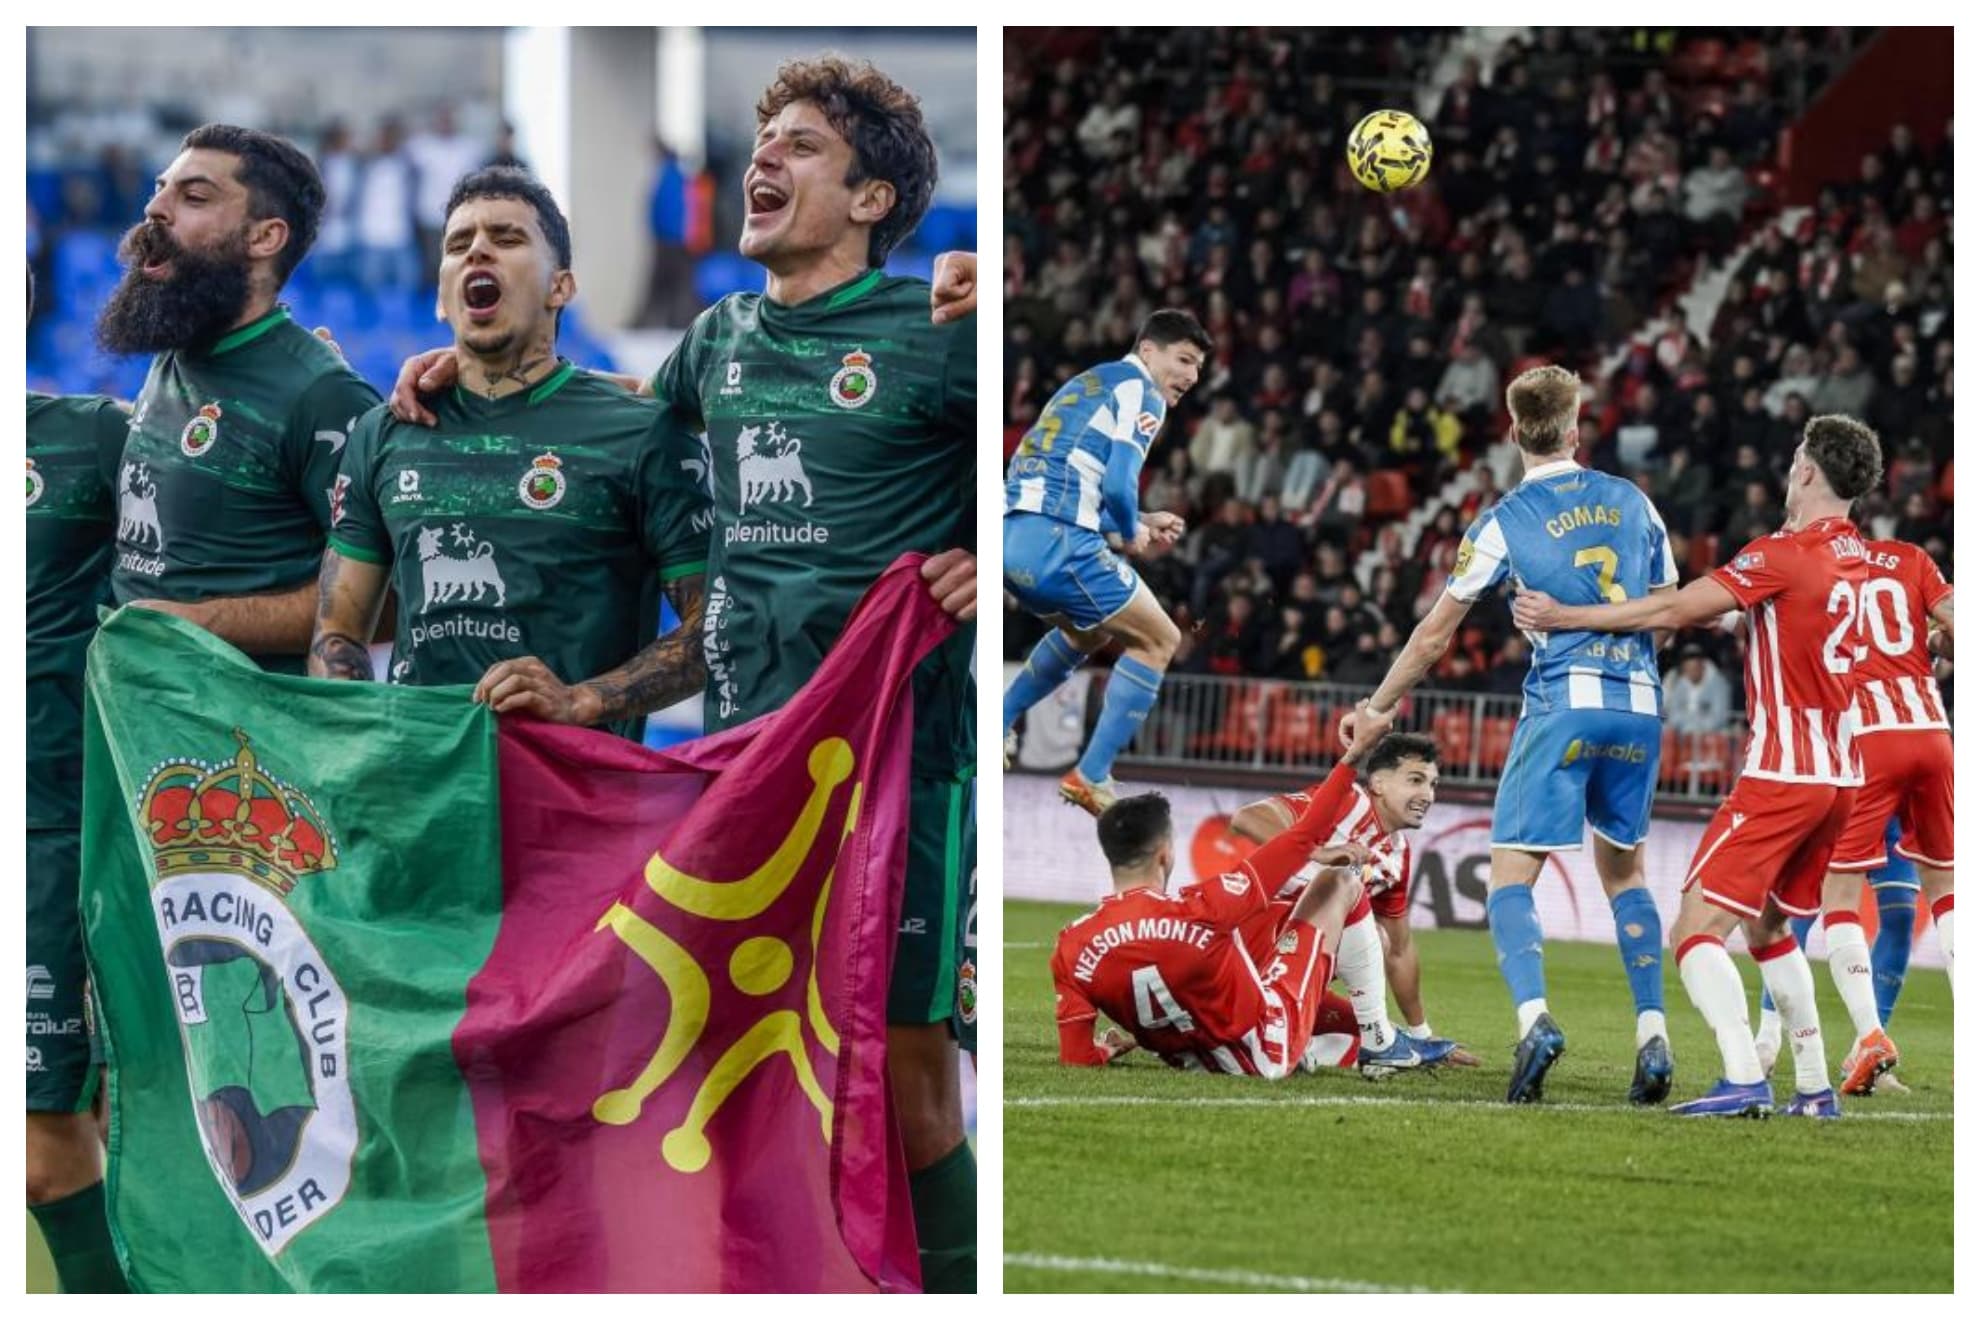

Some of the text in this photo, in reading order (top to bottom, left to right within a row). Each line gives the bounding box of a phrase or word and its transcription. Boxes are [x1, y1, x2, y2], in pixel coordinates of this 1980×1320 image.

[725, 520, 829, 548] plenitude
[1546, 505, 1621, 538] COMAS
[120, 551, 166, 577] nitude
[411, 614, 520, 648] plenitude
[703, 575, 732, 719] CANTABRIA
[160, 891, 274, 947] RACING
[1074, 918, 1215, 982] NELSON MONTE
[294, 962, 338, 1079] CLUB
[1131, 965, 1195, 1033] 4
[254, 1178, 328, 1240] DER
